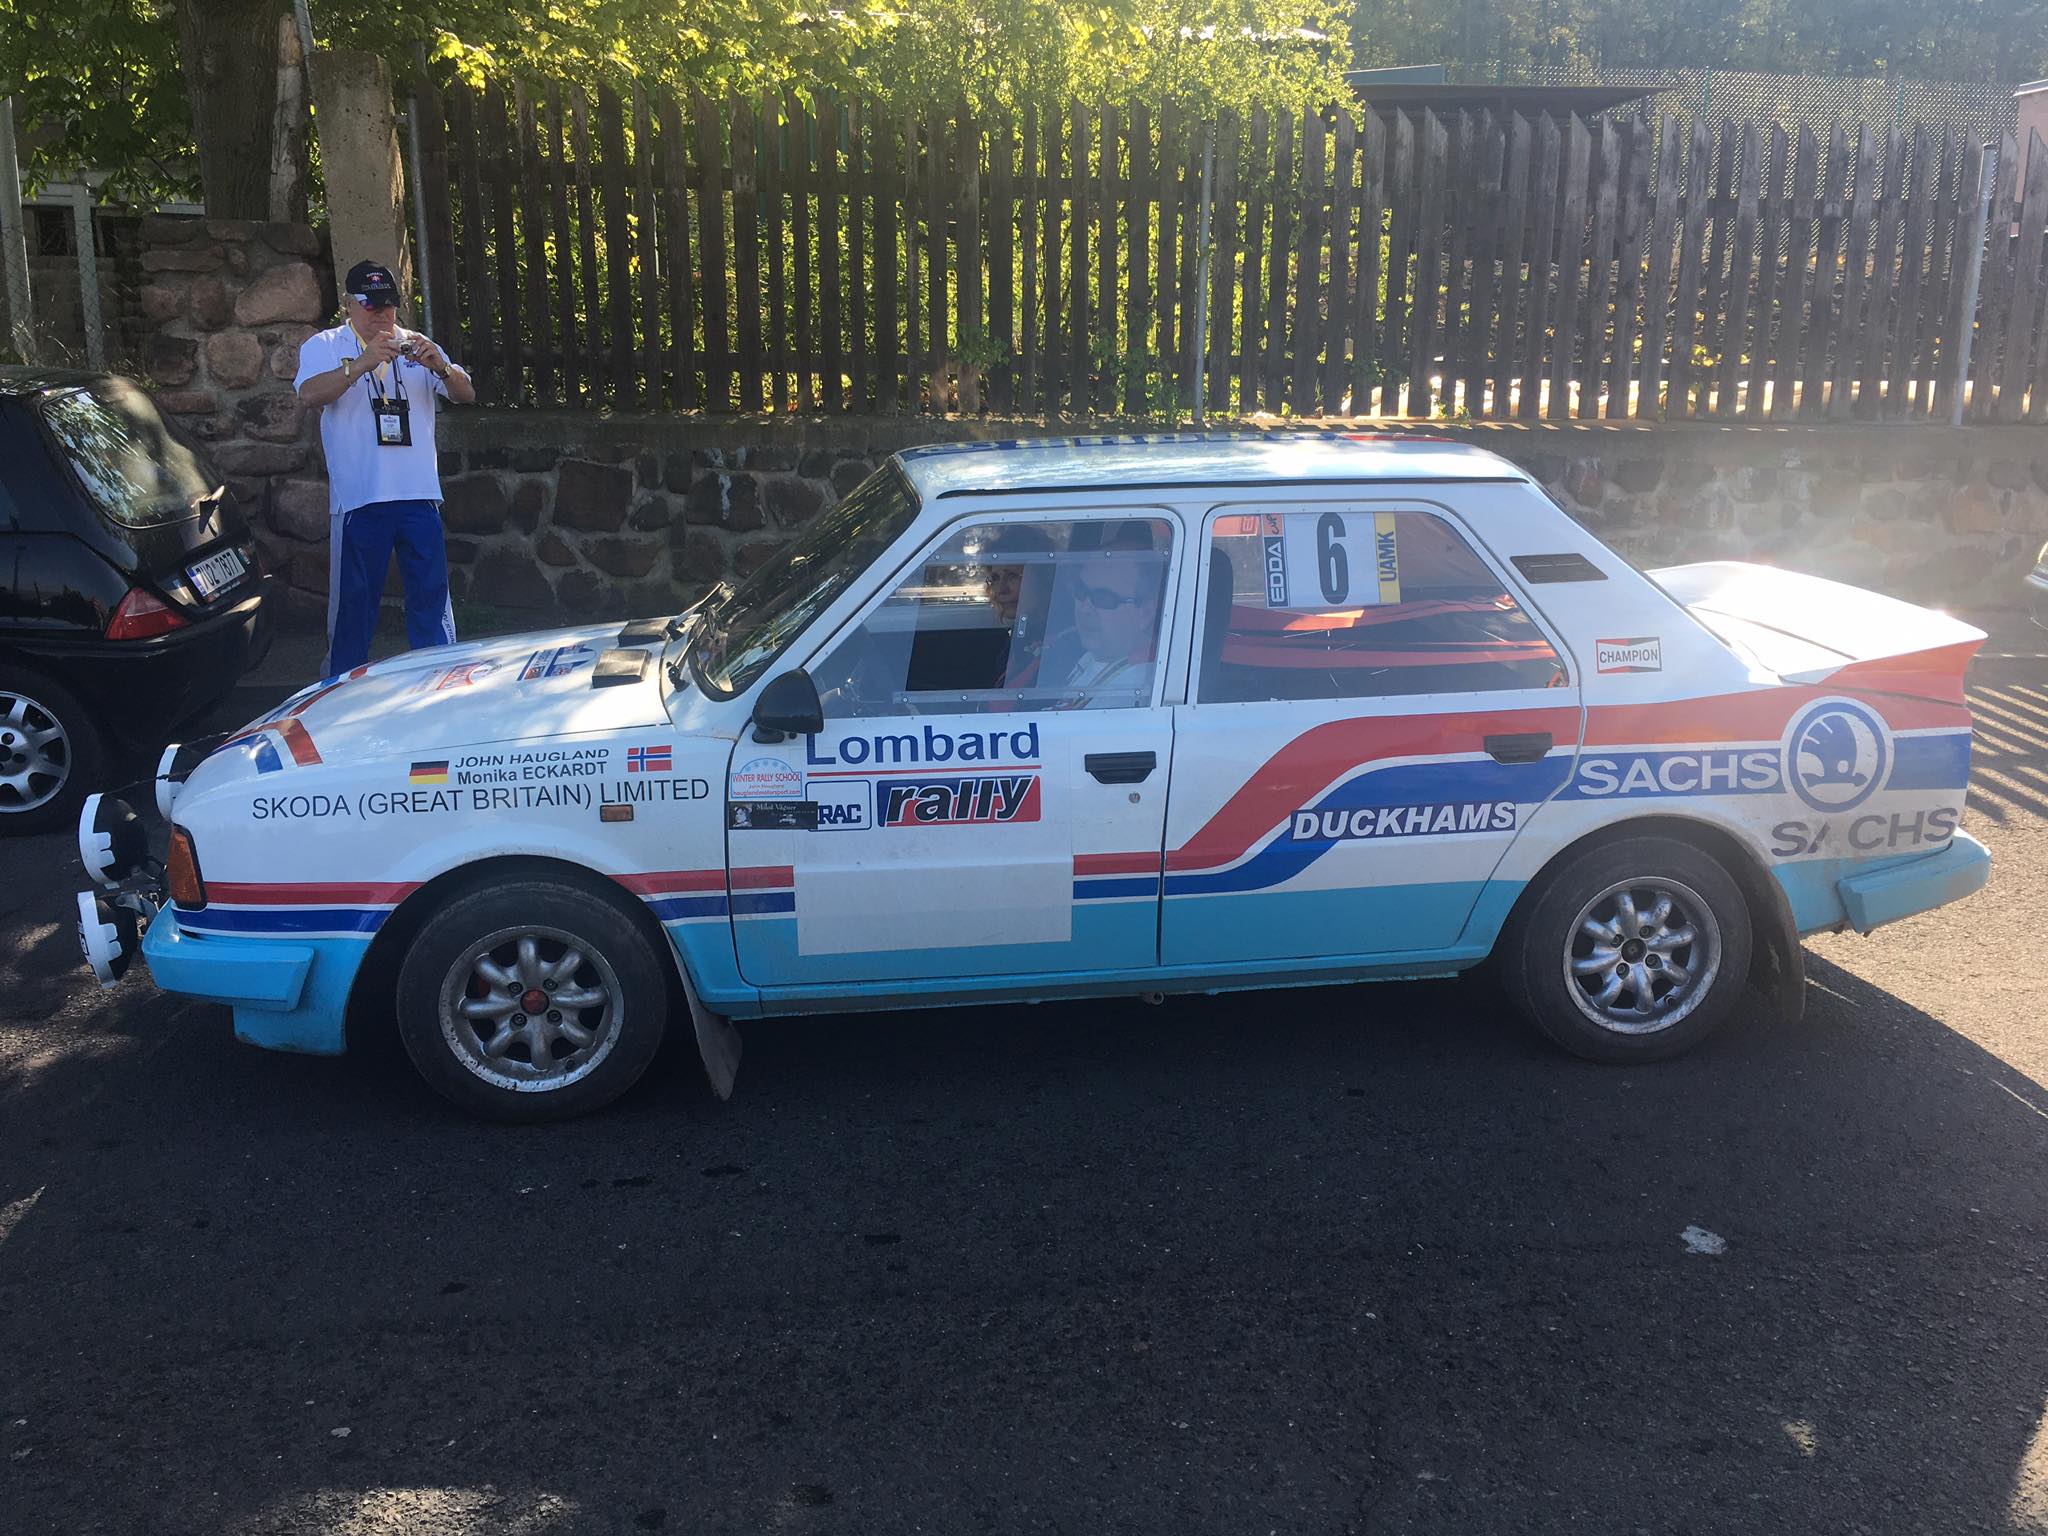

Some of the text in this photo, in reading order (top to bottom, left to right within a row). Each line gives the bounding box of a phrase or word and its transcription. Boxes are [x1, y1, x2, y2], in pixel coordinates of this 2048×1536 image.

[195, 564, 221, 591] 7U2
[214, 552, 240, 581] 7877
[1267, 541, 1286, 603] EDDA
[1317, 512, 1349, 605] 6
[1599, 649, 1658, 664] CHAMPION
[455, 748, 610, 768] JOHN HAUGLAND
[806, 722, 1040, 765] Lombard
[458, 761, 608, 785] Monika ECKARDT
[732, 772, 801, 783] WINTER RALLY SCHOOL
[1578, 752, 1780, 795] SACHS
[252, 778, 709, 820] SKODA (GREAT BRITAIN) LIMITED
[817, 804, 861, 825] RAC
[884, 776, 1036, 824] rally
[1292, 801, 1516, 841] DUCKHAMS
